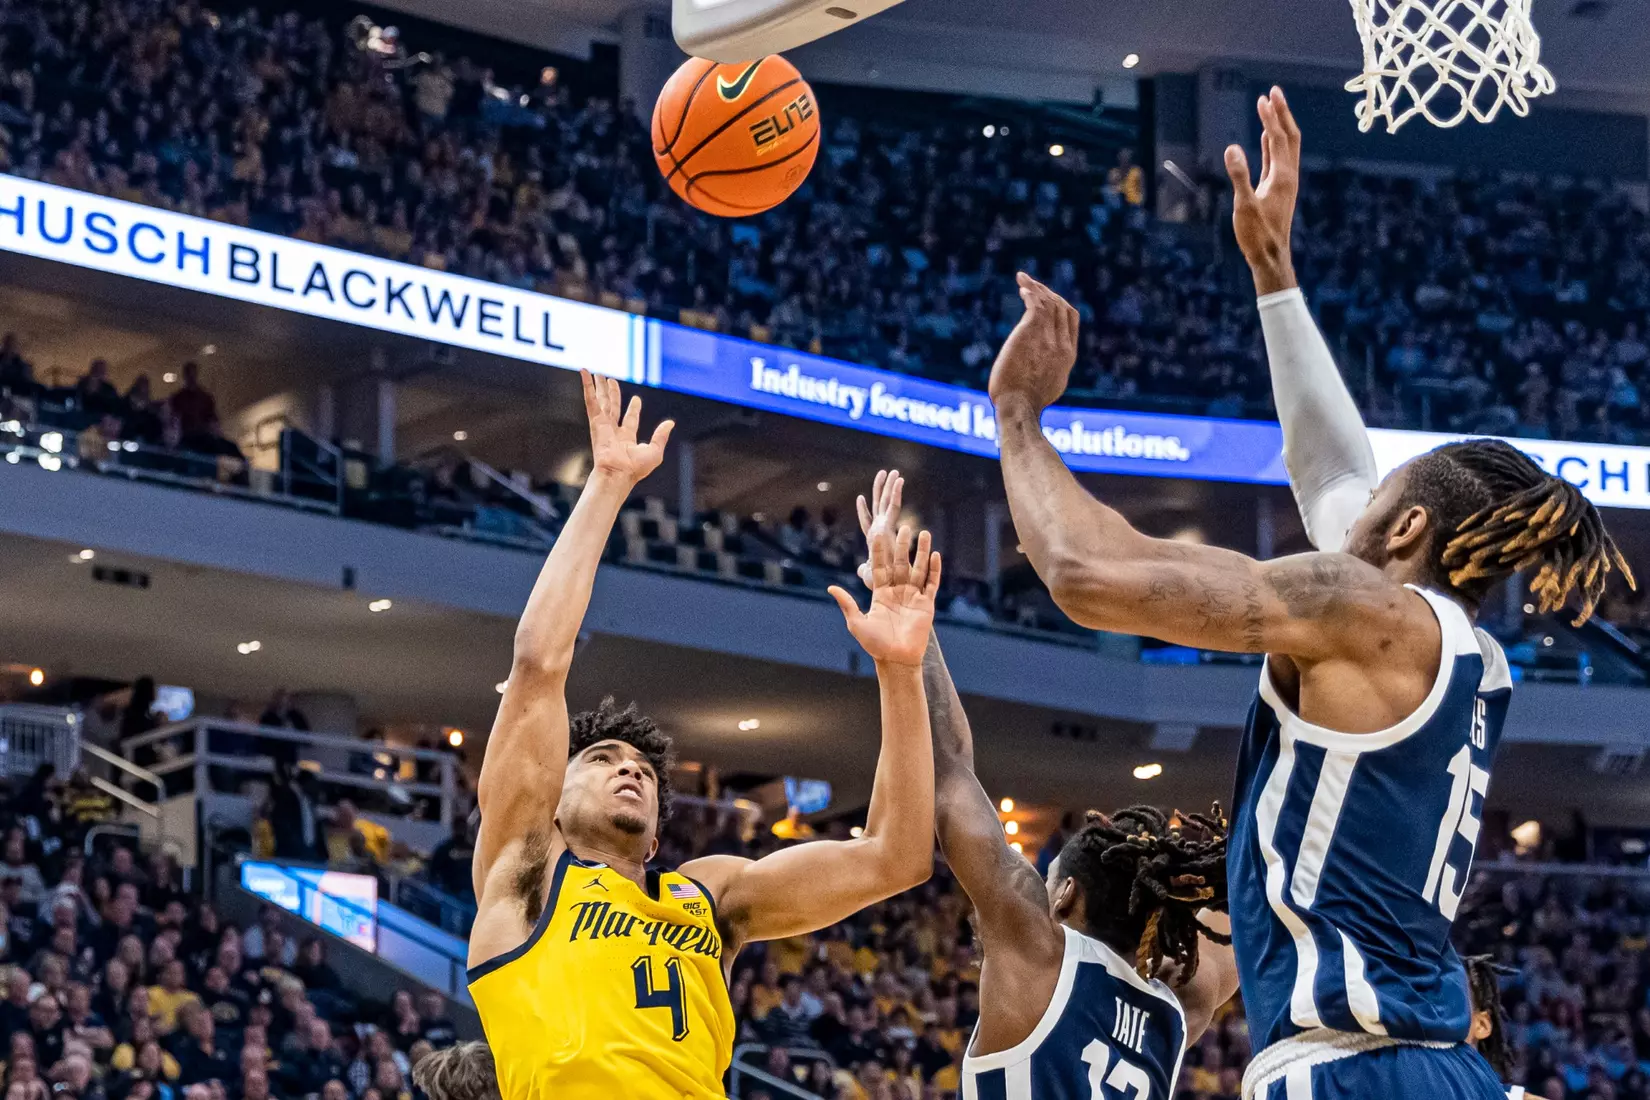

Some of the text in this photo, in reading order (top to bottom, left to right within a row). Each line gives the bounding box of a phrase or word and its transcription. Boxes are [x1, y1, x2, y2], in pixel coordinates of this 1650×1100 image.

[749, 93, 814, 146] ELITE
[0, 195, 565, 352] HUSCH BLACKWELL
[750, 356, 867, 420] Industry
[869, 381, 971, 436] focused
[1421, 743, 1490, 922] 15
[682, 902, 701, 910] BIG
[685, 908, 708, 916] AST
[631, 955, 690, 1042] 4
[1111, 996, 1150, 1054] TATE
